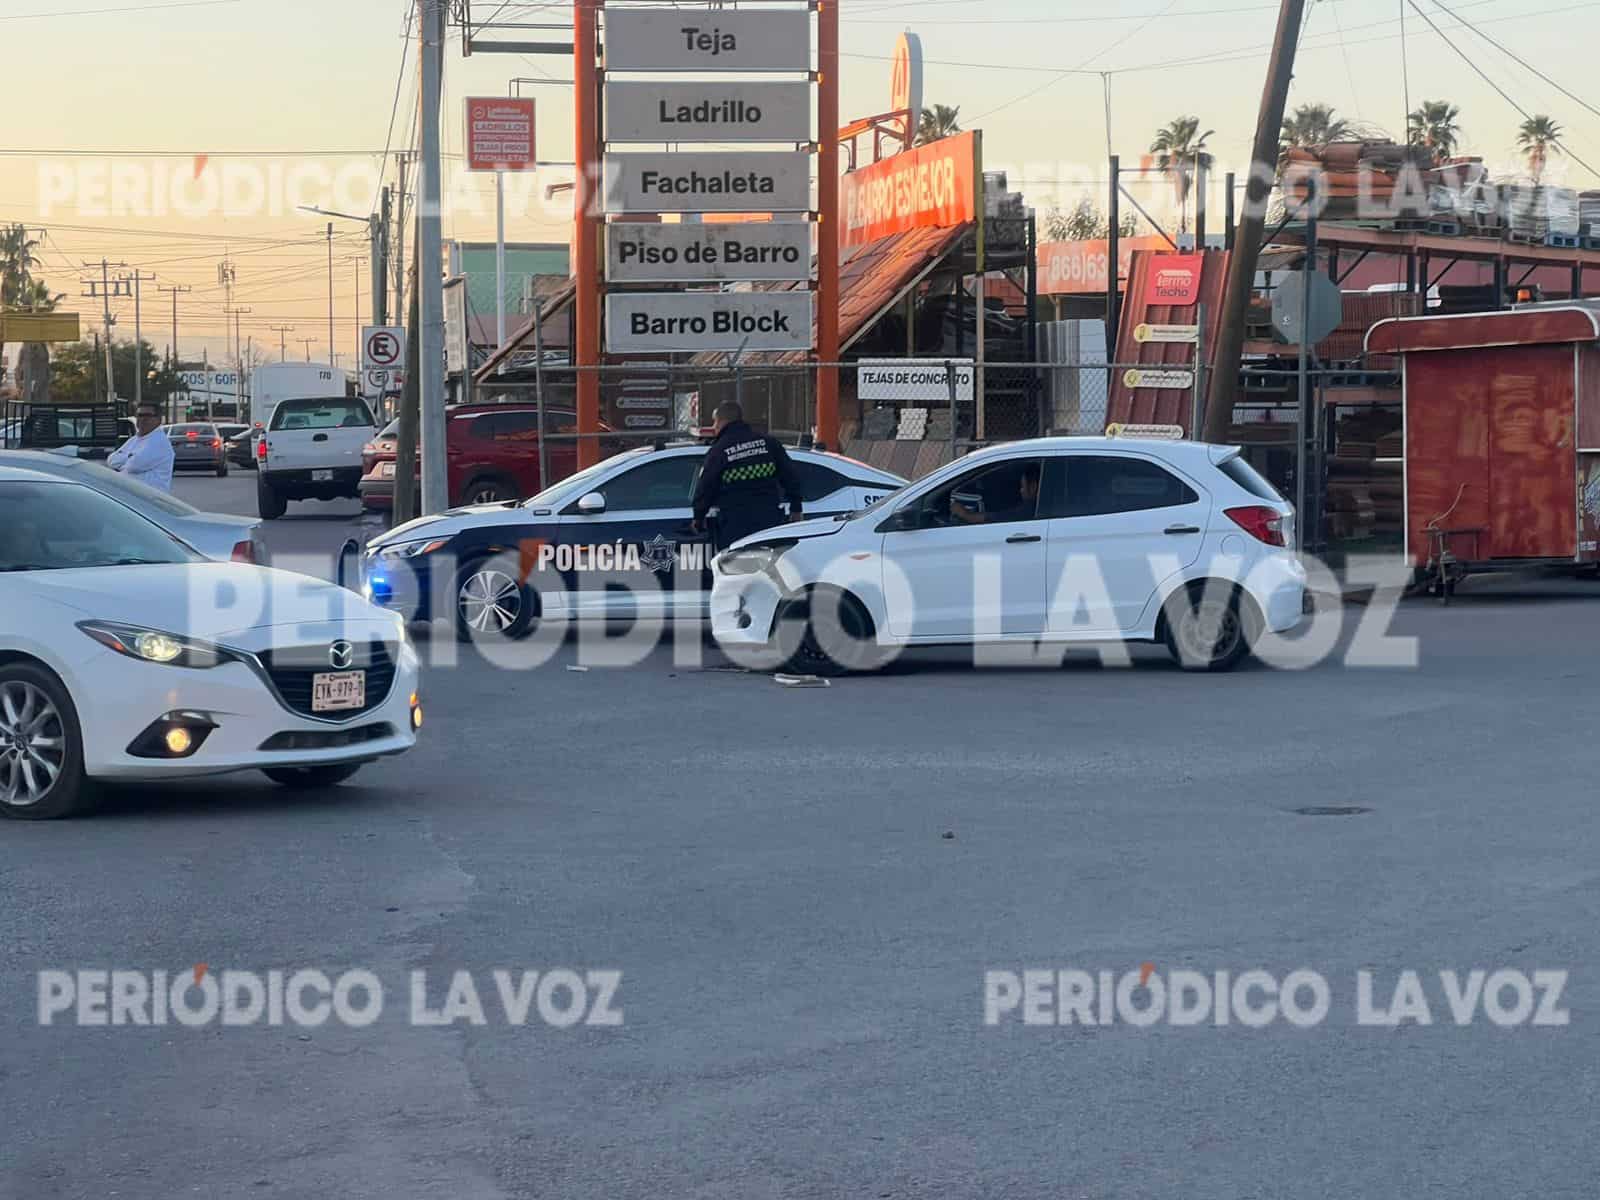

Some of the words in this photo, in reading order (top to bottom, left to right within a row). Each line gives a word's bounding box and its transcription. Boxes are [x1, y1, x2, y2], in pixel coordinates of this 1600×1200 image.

[681, 27, 737, 55] Teja
[659, 100, 762, 123] Ladrillo
[641, 171, 775, 194] Fachaleta
[619, 240, 679, 264] Piso
[684, 240, 718, 264] de
[724, 240, 800, 264] Barro
[1156, 286, 1189, 298] Techo
[631, 312, 707, 335] Barro
[712, 310, 790, 333] Block
[863, 373, 894, 384] TEJAS
[895, 373, 909, 384] DE
[911, 373, 970, 385] CONCRTO
[538, 538, 641, 572] POLICÍA
